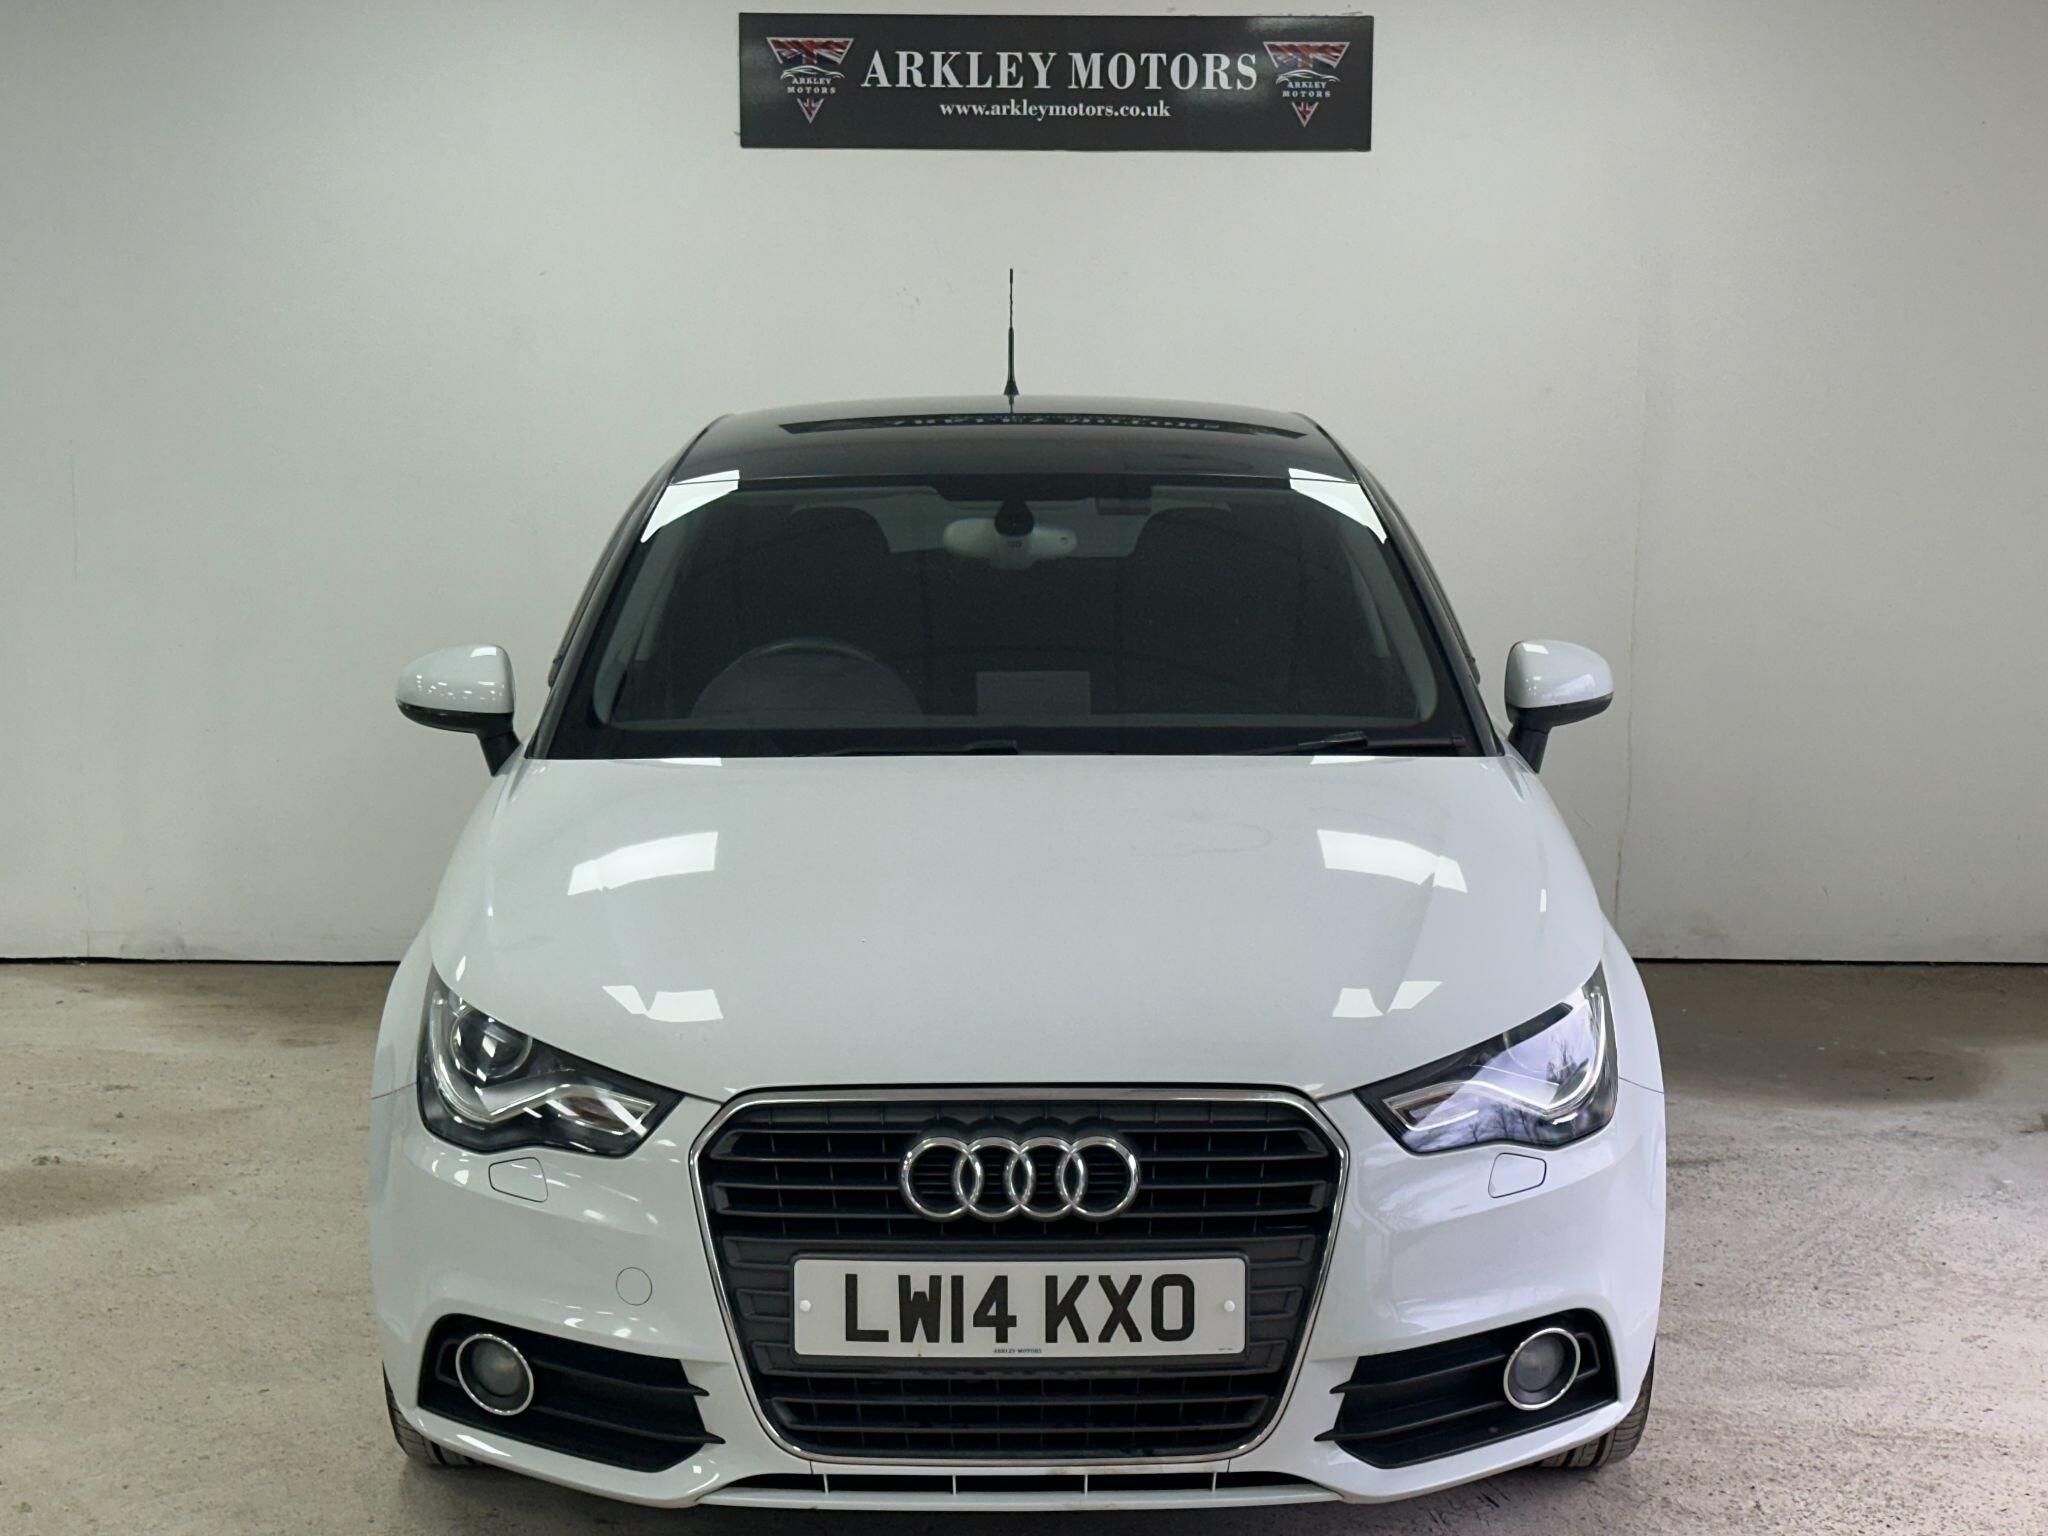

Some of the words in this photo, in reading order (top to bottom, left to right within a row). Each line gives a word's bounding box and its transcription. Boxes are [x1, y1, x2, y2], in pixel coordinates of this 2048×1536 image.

[861, 50, 1057, 89] ARKLEY
[1068, 52, 1257, 90] MOTORS
[939, 99, 1171, 122] www.arkleymotors.co.uk
[845, 1273, 1017, 1343] LW14
[1045, 1273, 1195, 1343] KXO
